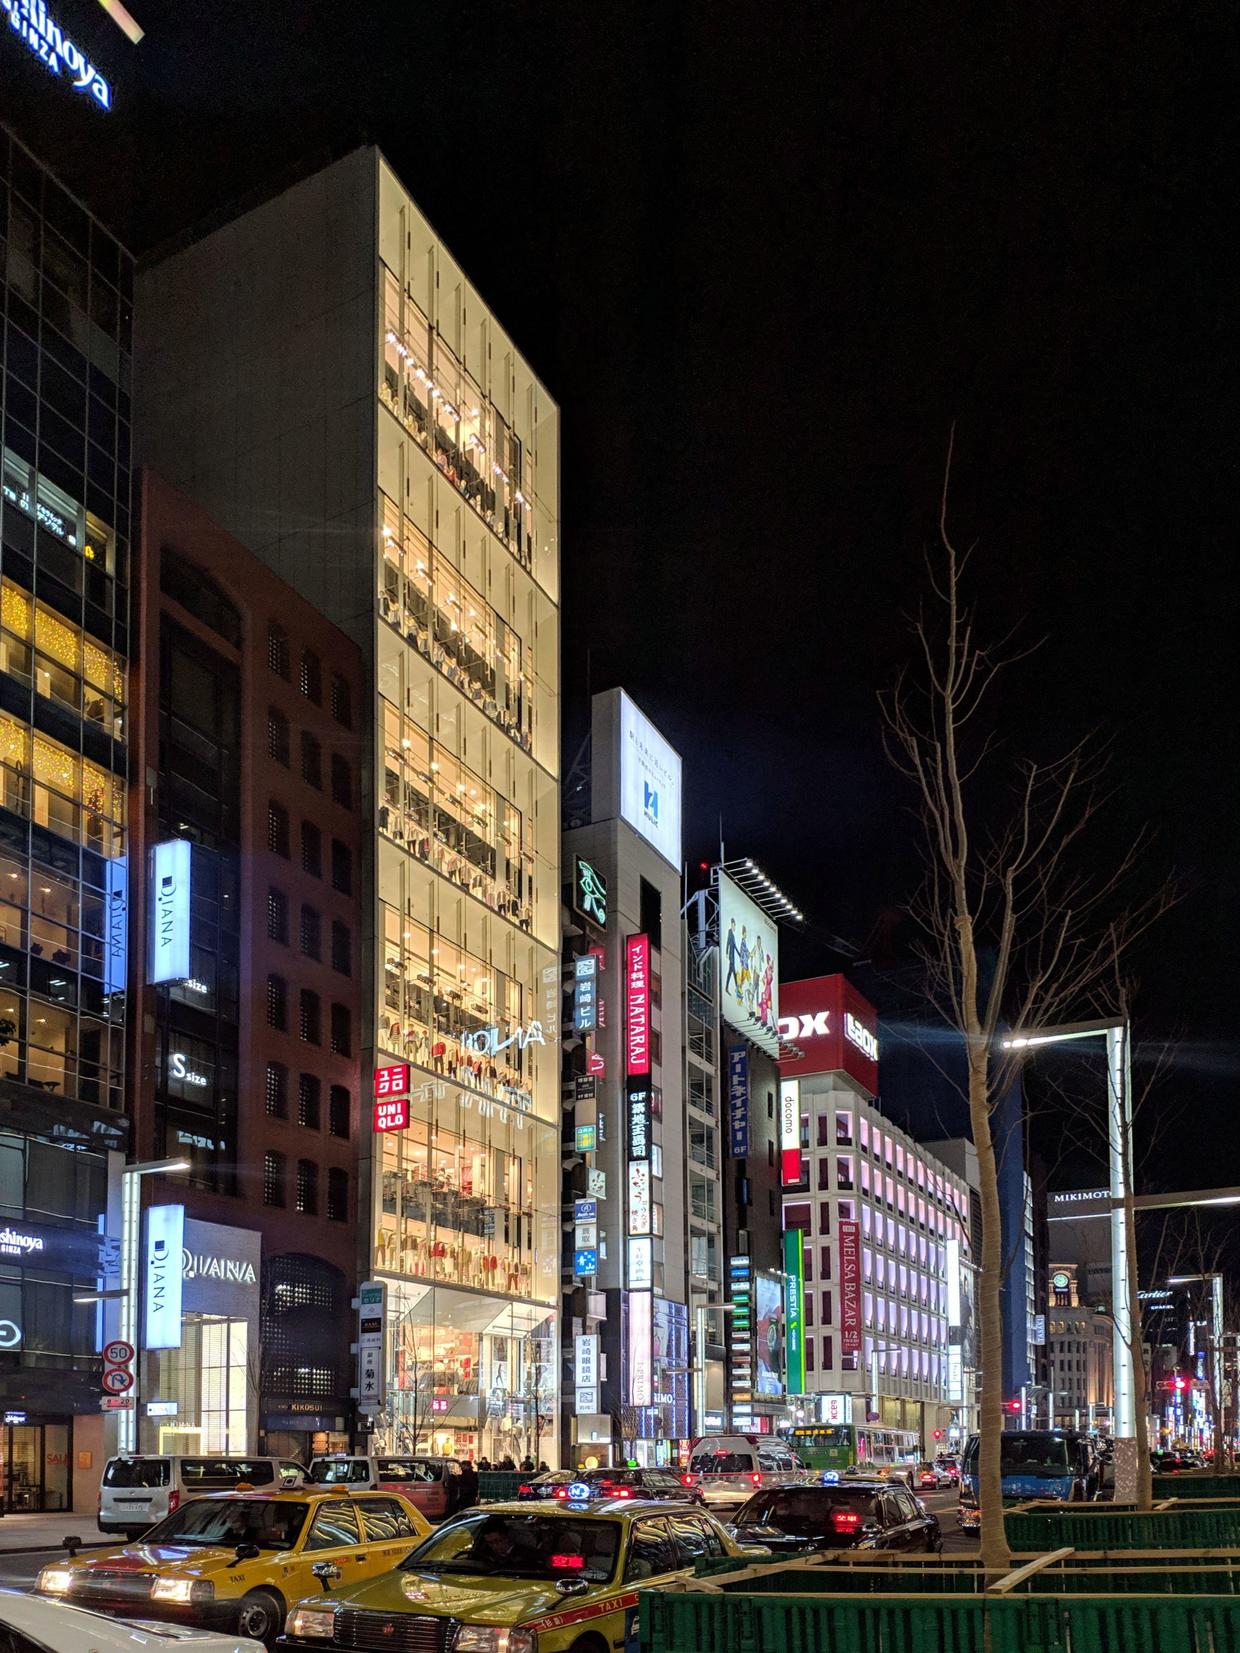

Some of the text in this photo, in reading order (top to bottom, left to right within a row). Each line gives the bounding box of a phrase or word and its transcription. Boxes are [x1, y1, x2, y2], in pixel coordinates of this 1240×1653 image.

[160, 884, 177, 948] DIANA
[629, 993, 646, 1065] NATARAJ
[186, 1072, 207, 1086] size
[378, 1103, 402, 1116] UNI
[630, 1092, 647, 1102] 6F
[378, 1114, 404, 1128] QLO
[784, 1096, 795, 1134] docomo
[843, 1235, 856, 1281] MELSA
[152, 1249, 169, 1313] DIANA
[844, 1284, 857, 1327] BAZAR
[110, 1348, 127, 1358] 50
[598, 1599, 623, 1613] TAXI
